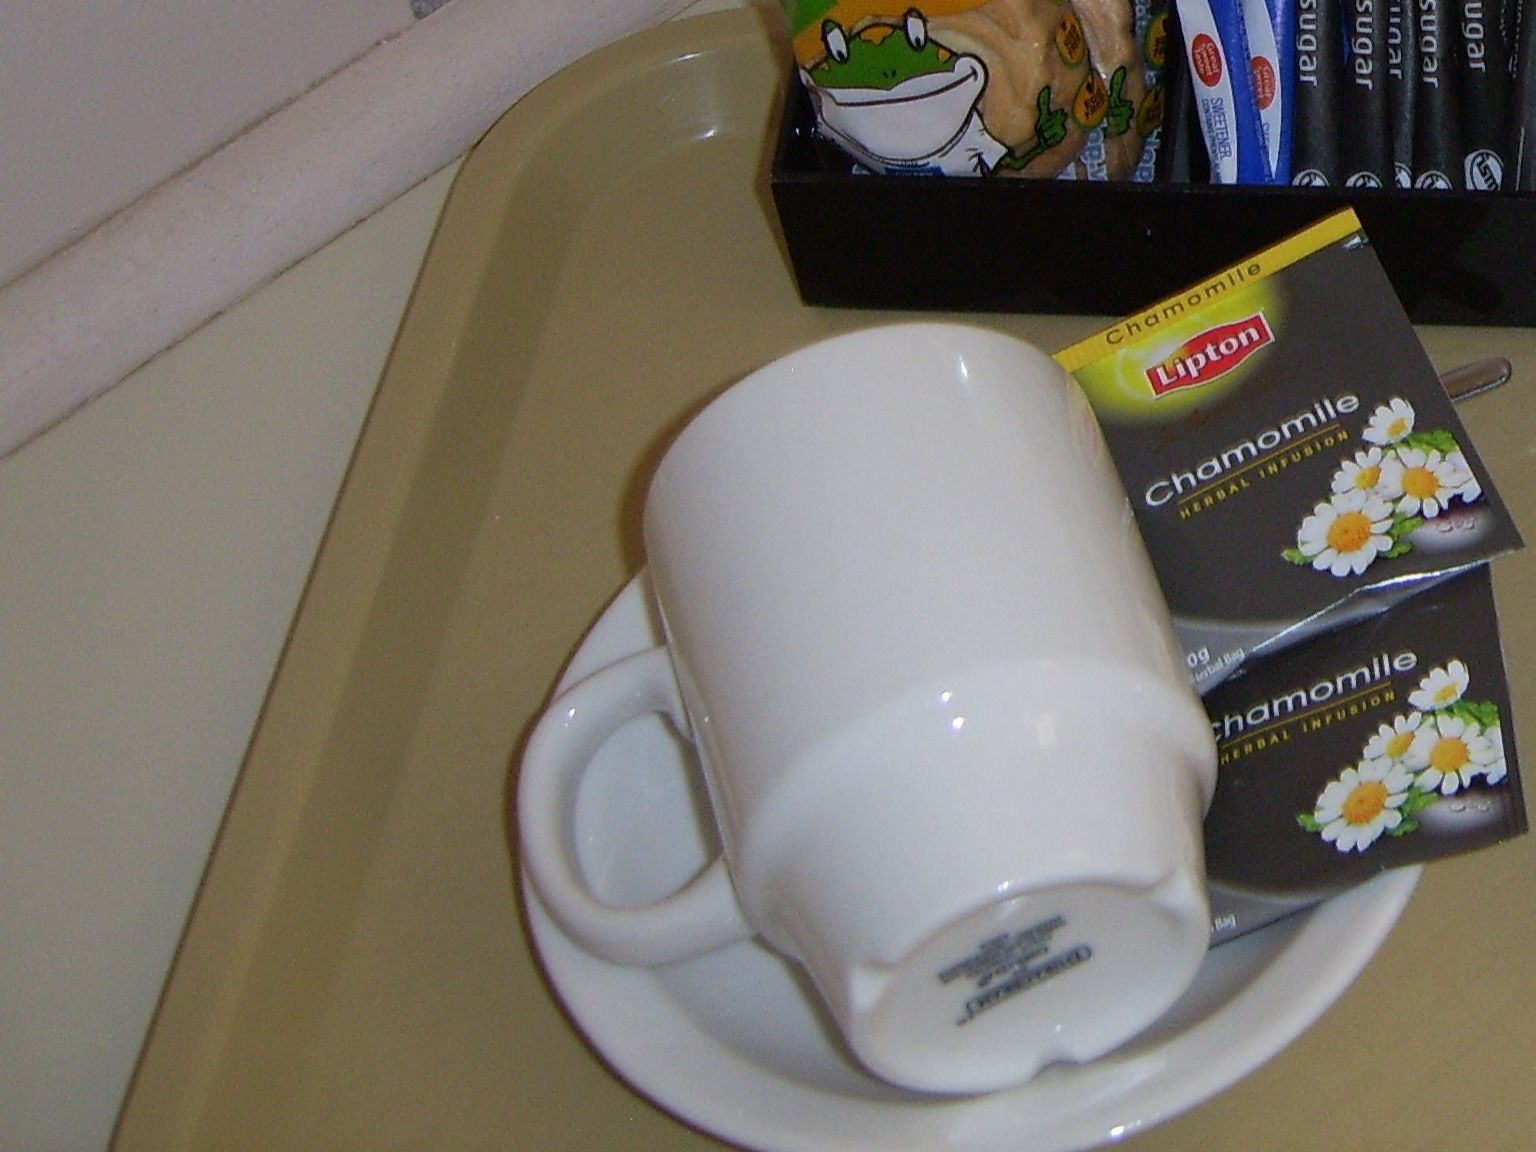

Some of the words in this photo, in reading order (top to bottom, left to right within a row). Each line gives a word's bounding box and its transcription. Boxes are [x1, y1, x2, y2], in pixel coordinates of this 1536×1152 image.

[1351, 0, 1373, 90] sugar
[1210, 97, 1233, 158] SWEETENER
[1105, 262, 1262, 346] Chamomile
[1155, 325, 1261, 386] Lipton
[1144, 393, 1360, 508] Chamomile
[1179, 478, 1251, 521] HERBAL
[1258, 429, 1350, 481] INFUSION
[1220, 729, 1290, 767] HERBAL
[1302, 690, 1396, 734] INFUSION
